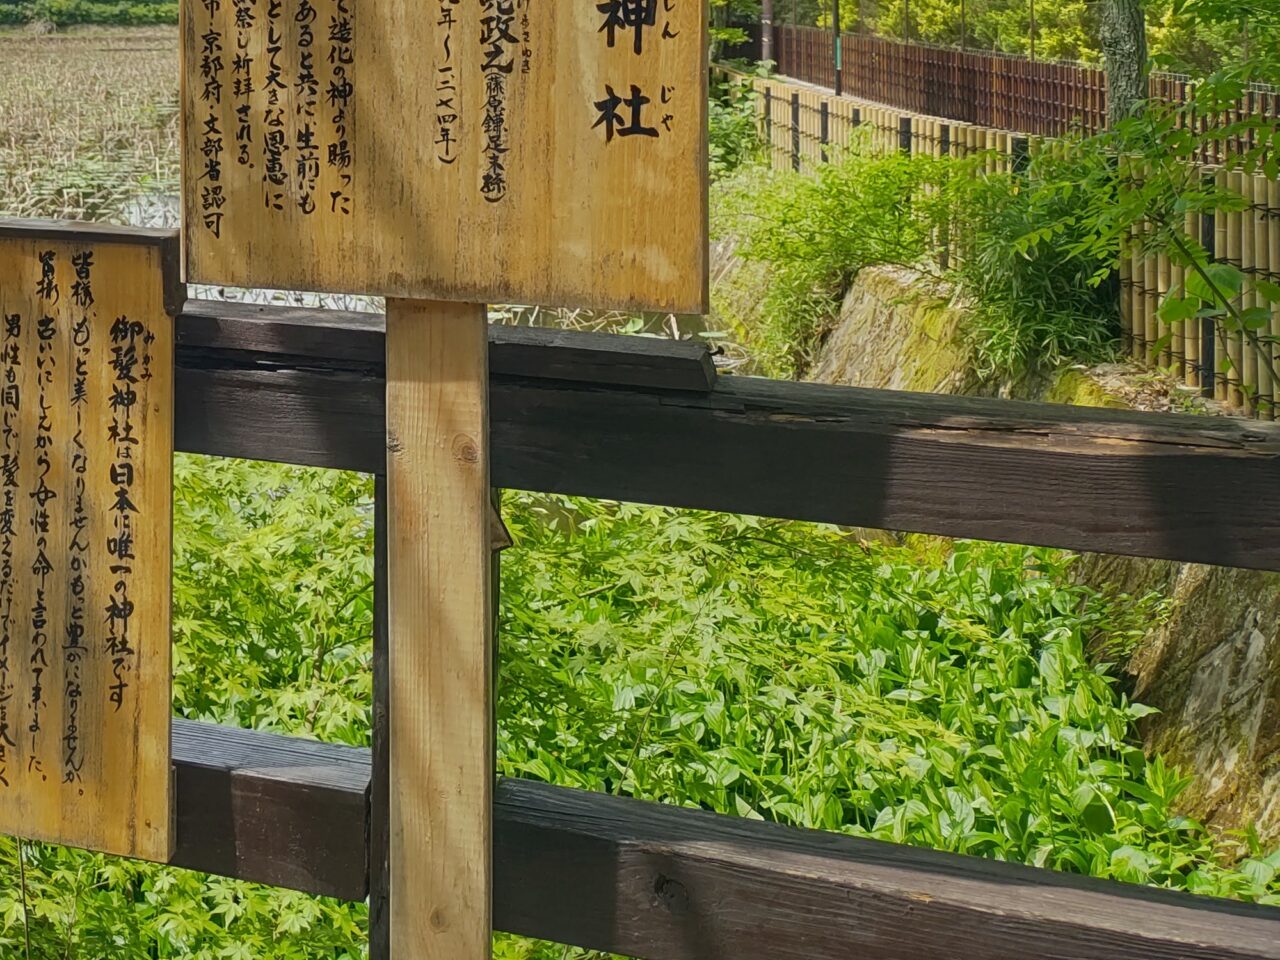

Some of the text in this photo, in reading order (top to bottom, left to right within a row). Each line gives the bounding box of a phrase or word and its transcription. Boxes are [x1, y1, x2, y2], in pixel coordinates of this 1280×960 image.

[104, 315, 143, 713] 御髪神社は日本に唯一の神社です
